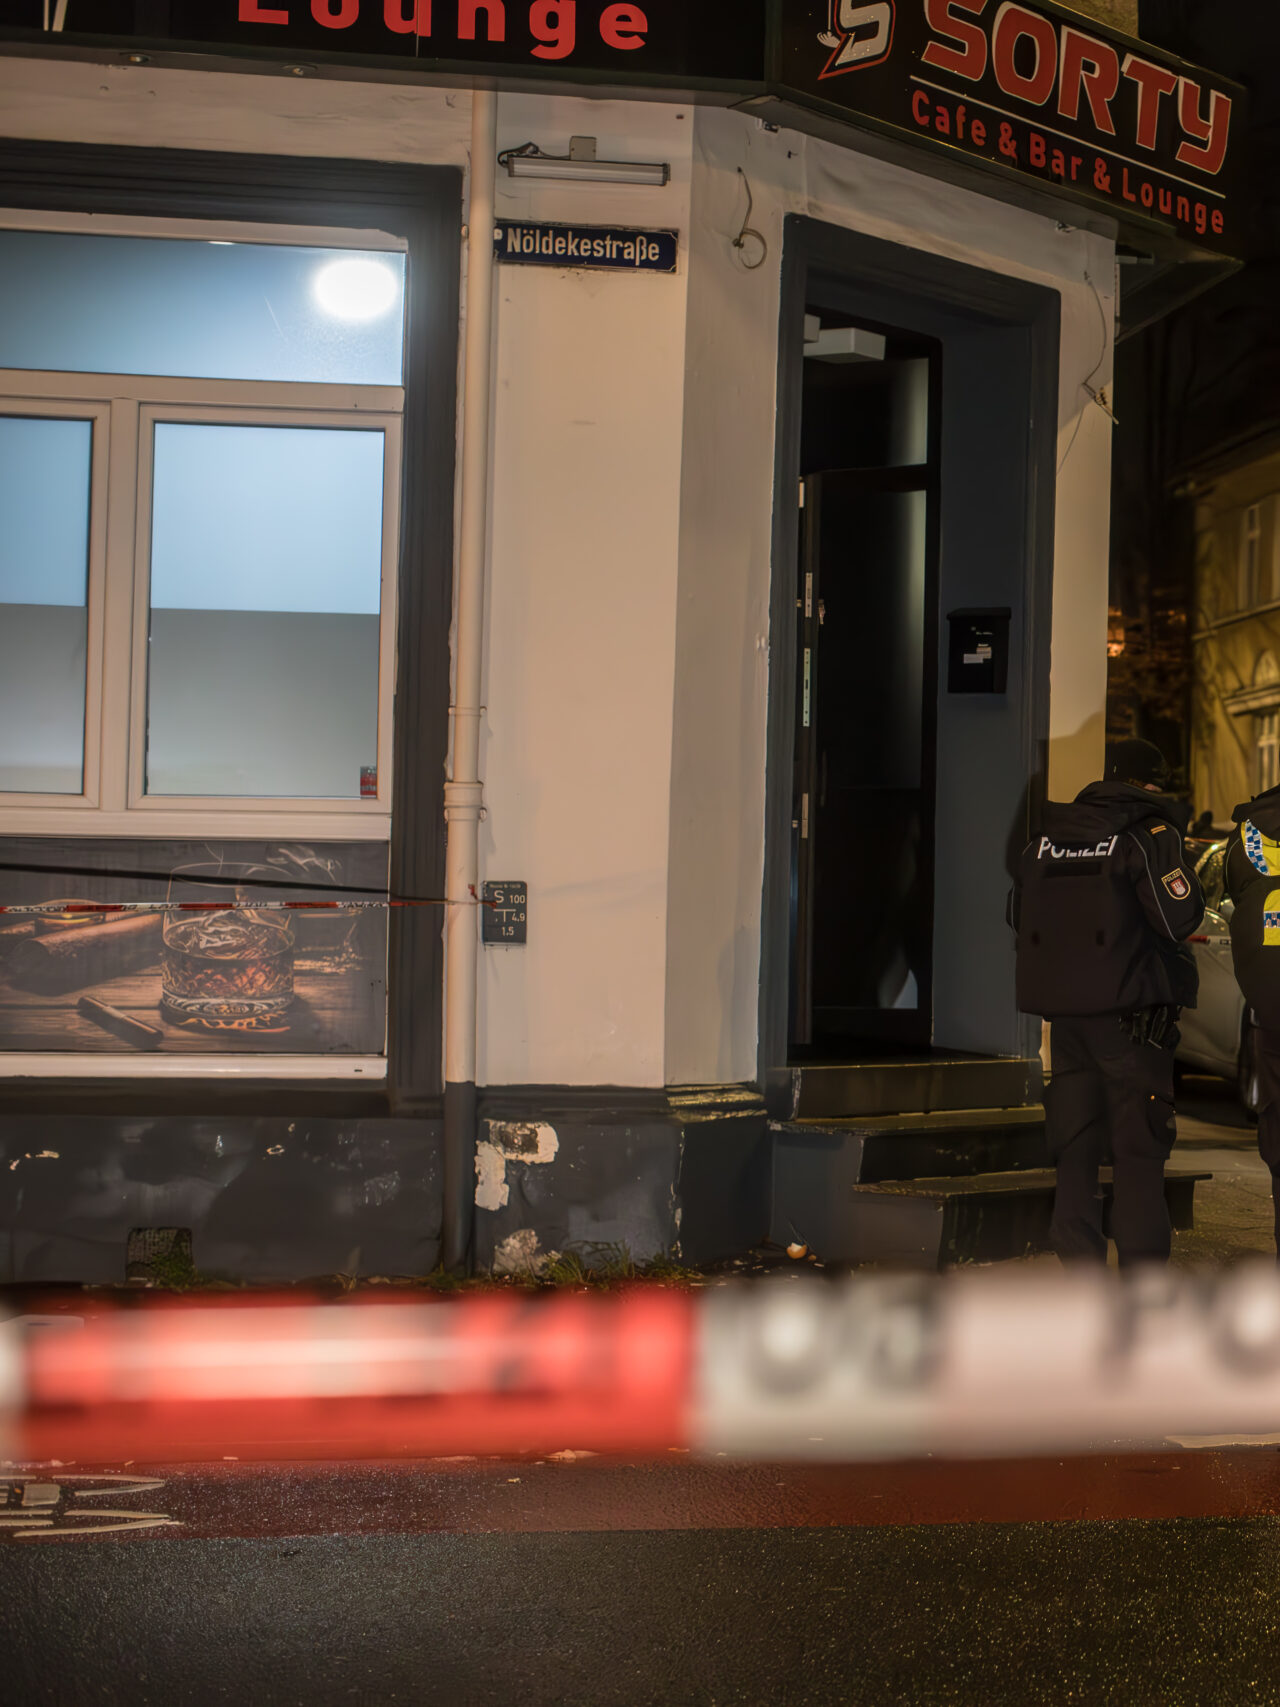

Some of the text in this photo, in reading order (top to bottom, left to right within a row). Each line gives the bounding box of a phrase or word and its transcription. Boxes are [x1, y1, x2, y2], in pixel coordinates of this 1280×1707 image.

[238, 0, 648, 59] Lounge
[922, 0, 1231, 175] SORTY
[912, 89, 1224, 234] Cafe & Bar & Lounge
[507, 227, 660, 266] Nöldekestraße
[494, 890, 525, 904] S 100
